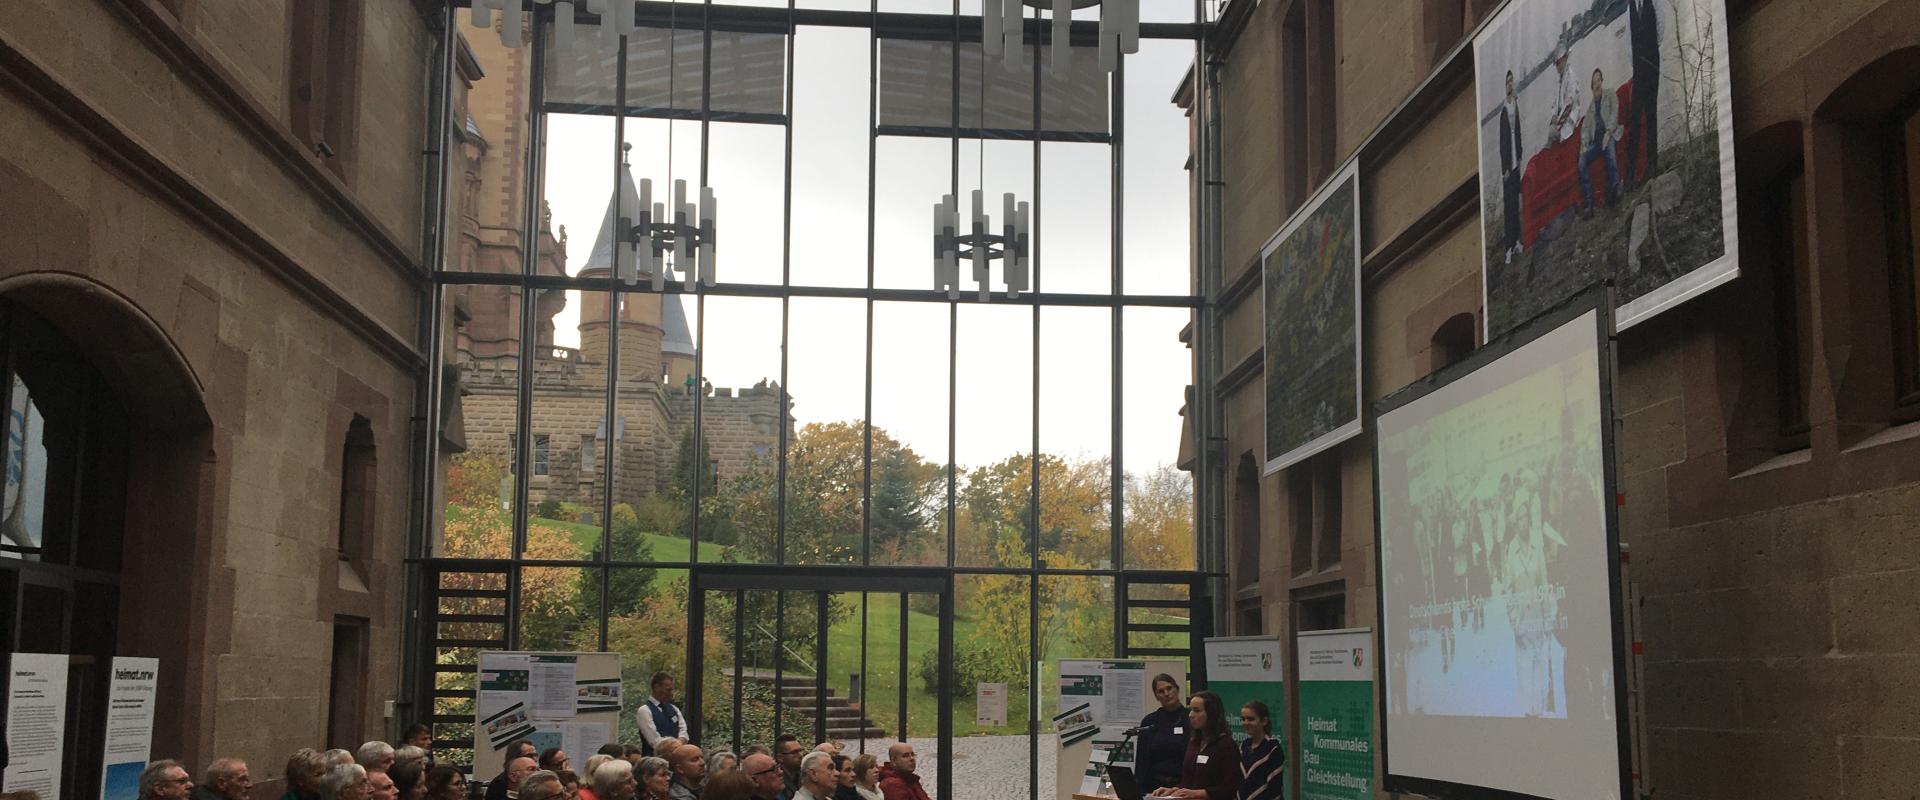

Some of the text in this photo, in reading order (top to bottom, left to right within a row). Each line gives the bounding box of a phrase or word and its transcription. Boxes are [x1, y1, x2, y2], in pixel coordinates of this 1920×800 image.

[115, 668, 154, 680] heimat.nrw
[1307, 716, 1337, 732] Heimat
[1313, 734, 1368, 752] Kommunales
[1303, 749, 1320, 764] Bau
[1307, 768, 1367, 792] Gleichstellung
